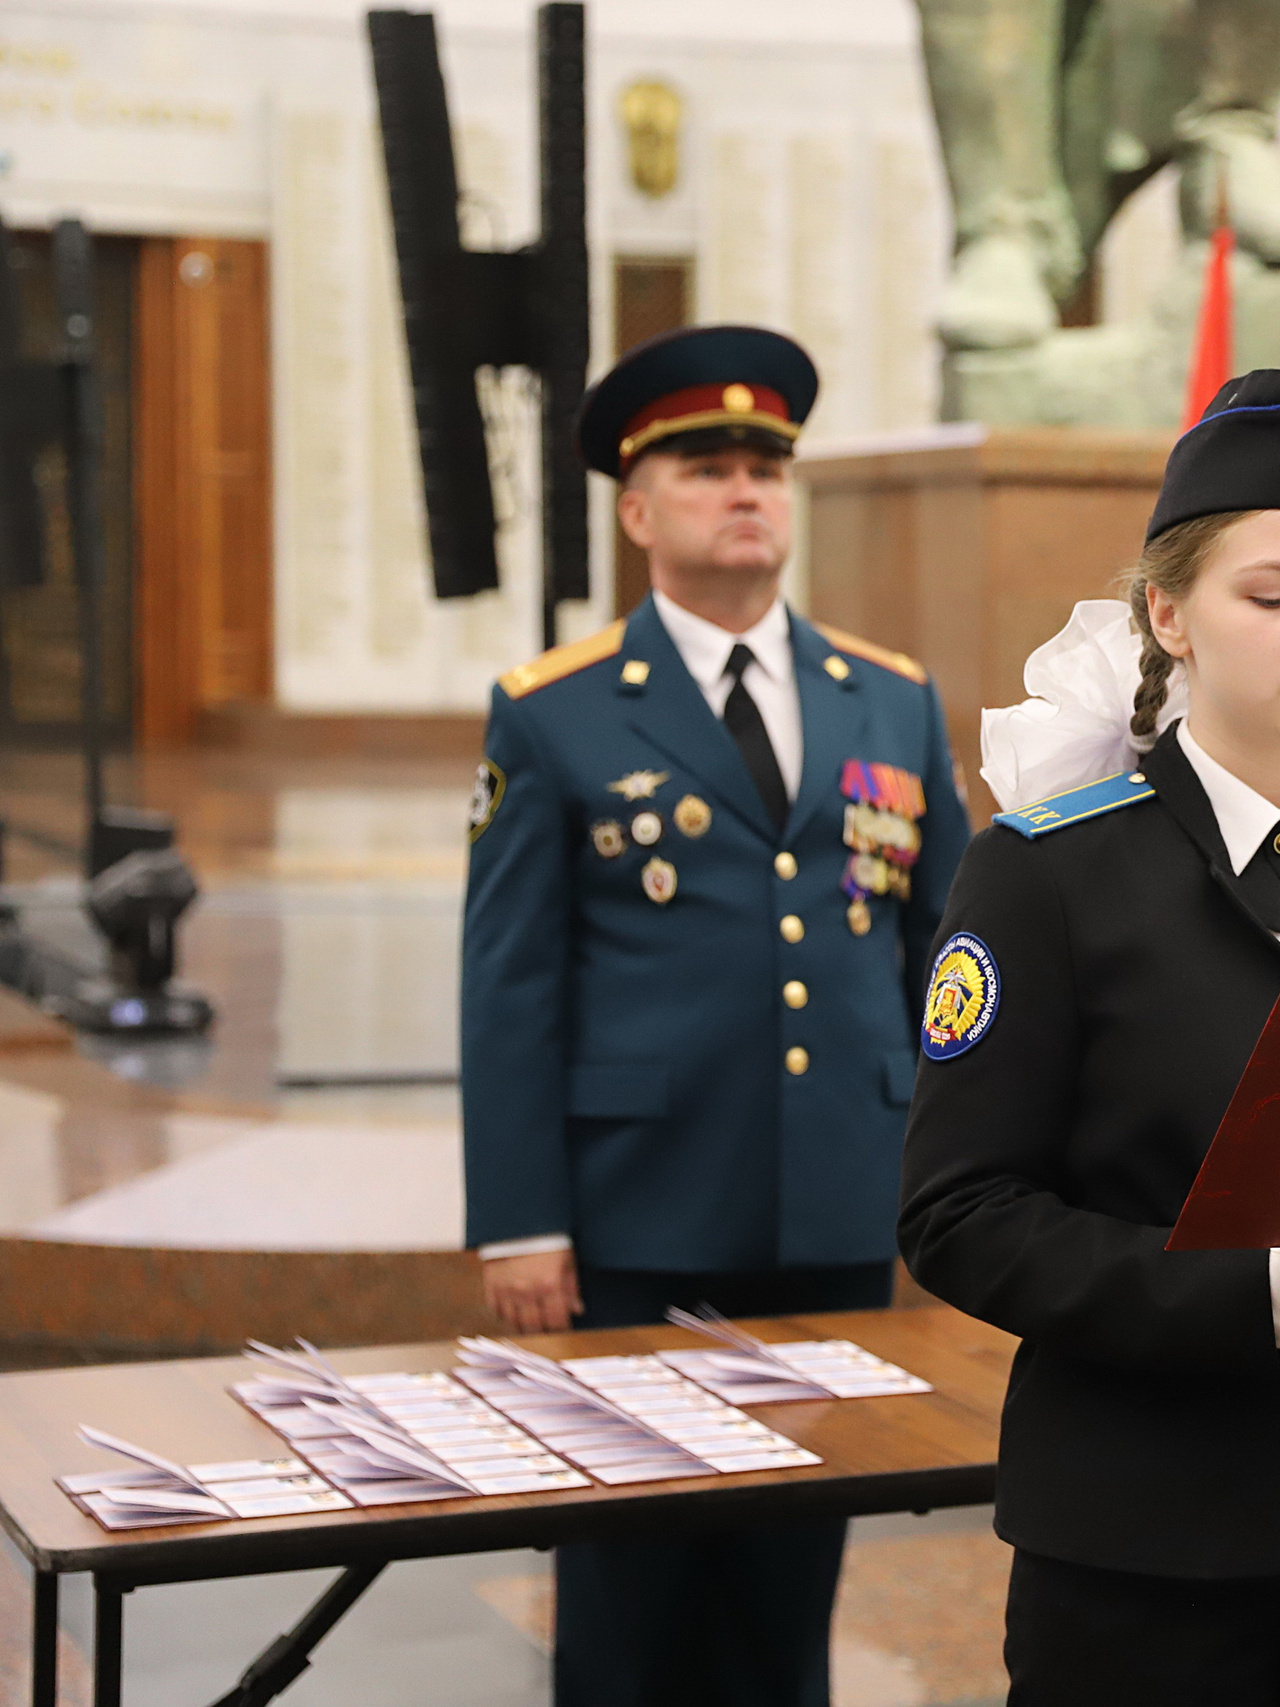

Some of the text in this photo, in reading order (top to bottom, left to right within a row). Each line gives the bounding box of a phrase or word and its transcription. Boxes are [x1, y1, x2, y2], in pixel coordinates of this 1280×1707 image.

[956, 936, 986, 961] АВИАЦИИ
[981, 957, 991, 967] И
[967, 966, 998, 1043] КОСМОНАВТИКИ
